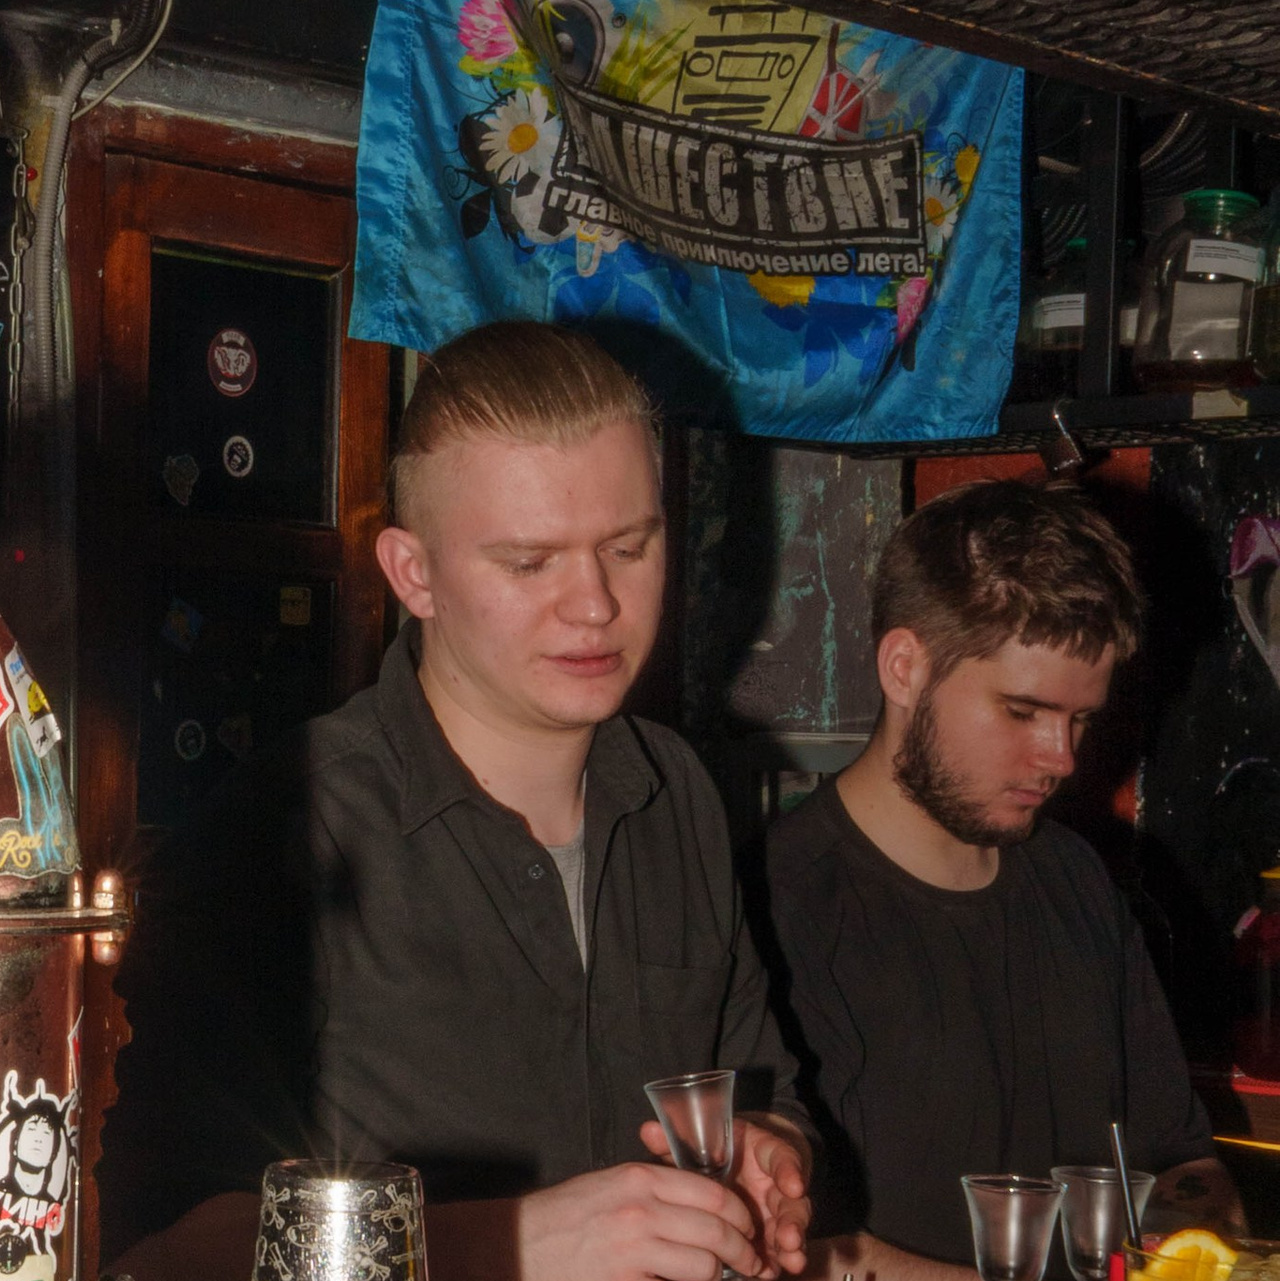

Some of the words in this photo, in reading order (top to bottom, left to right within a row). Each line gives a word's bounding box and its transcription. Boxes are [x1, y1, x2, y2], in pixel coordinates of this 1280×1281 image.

[548, 186, 656, 243] главное
[661, 232, 849, 275] приключение
[858, 251, 927, 275] лета!
